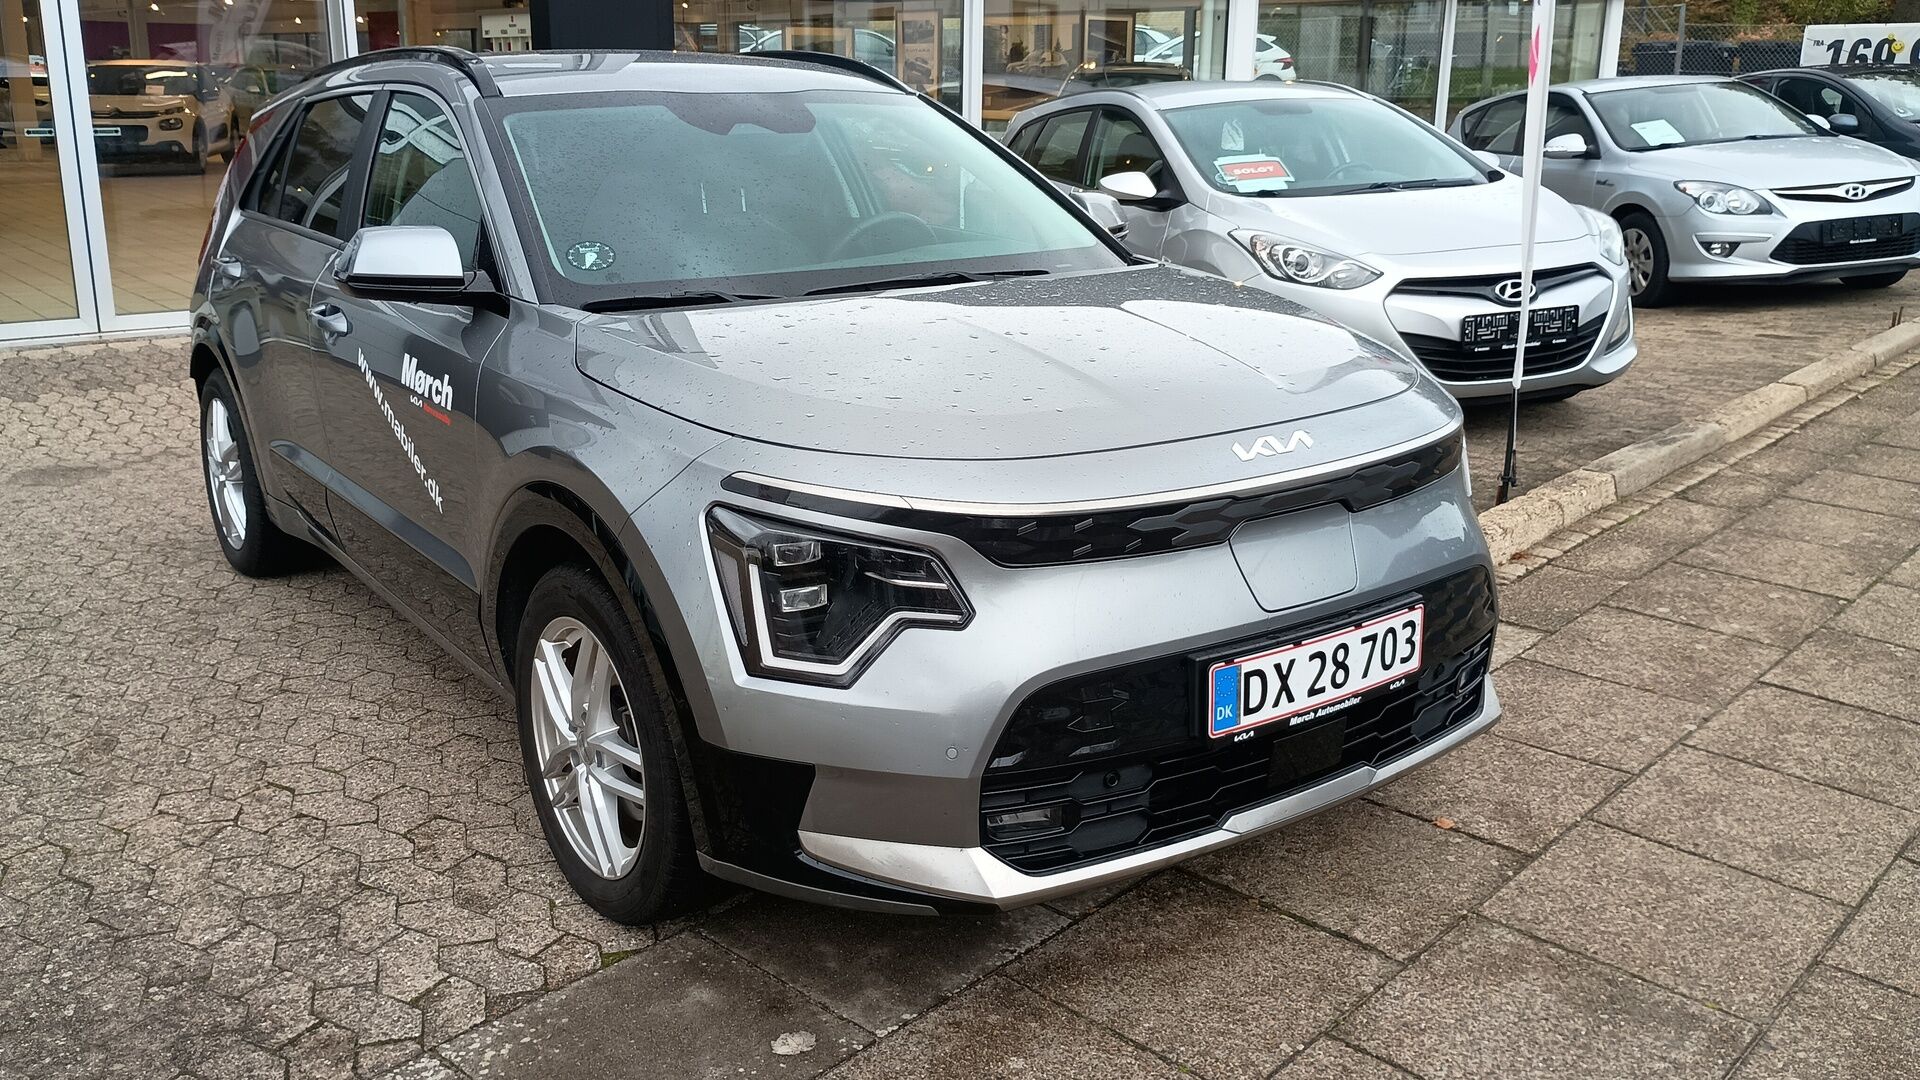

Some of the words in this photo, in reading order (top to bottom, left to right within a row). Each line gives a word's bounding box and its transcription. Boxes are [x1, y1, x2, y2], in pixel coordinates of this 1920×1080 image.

[401, 352, 453, 411] Mørch
[358, 347, 443, 514] www.mabiler.dk
[1231, 430, 1314, 462] KIA
[1243, 658, 1296, 717] DX
[1307, 642, 1350, 698] 28
[1360, 619, 1417, 680] 703
[1216, 704, 1233, 721] DK
[1315, 696, 1362, 718] Automobiler
